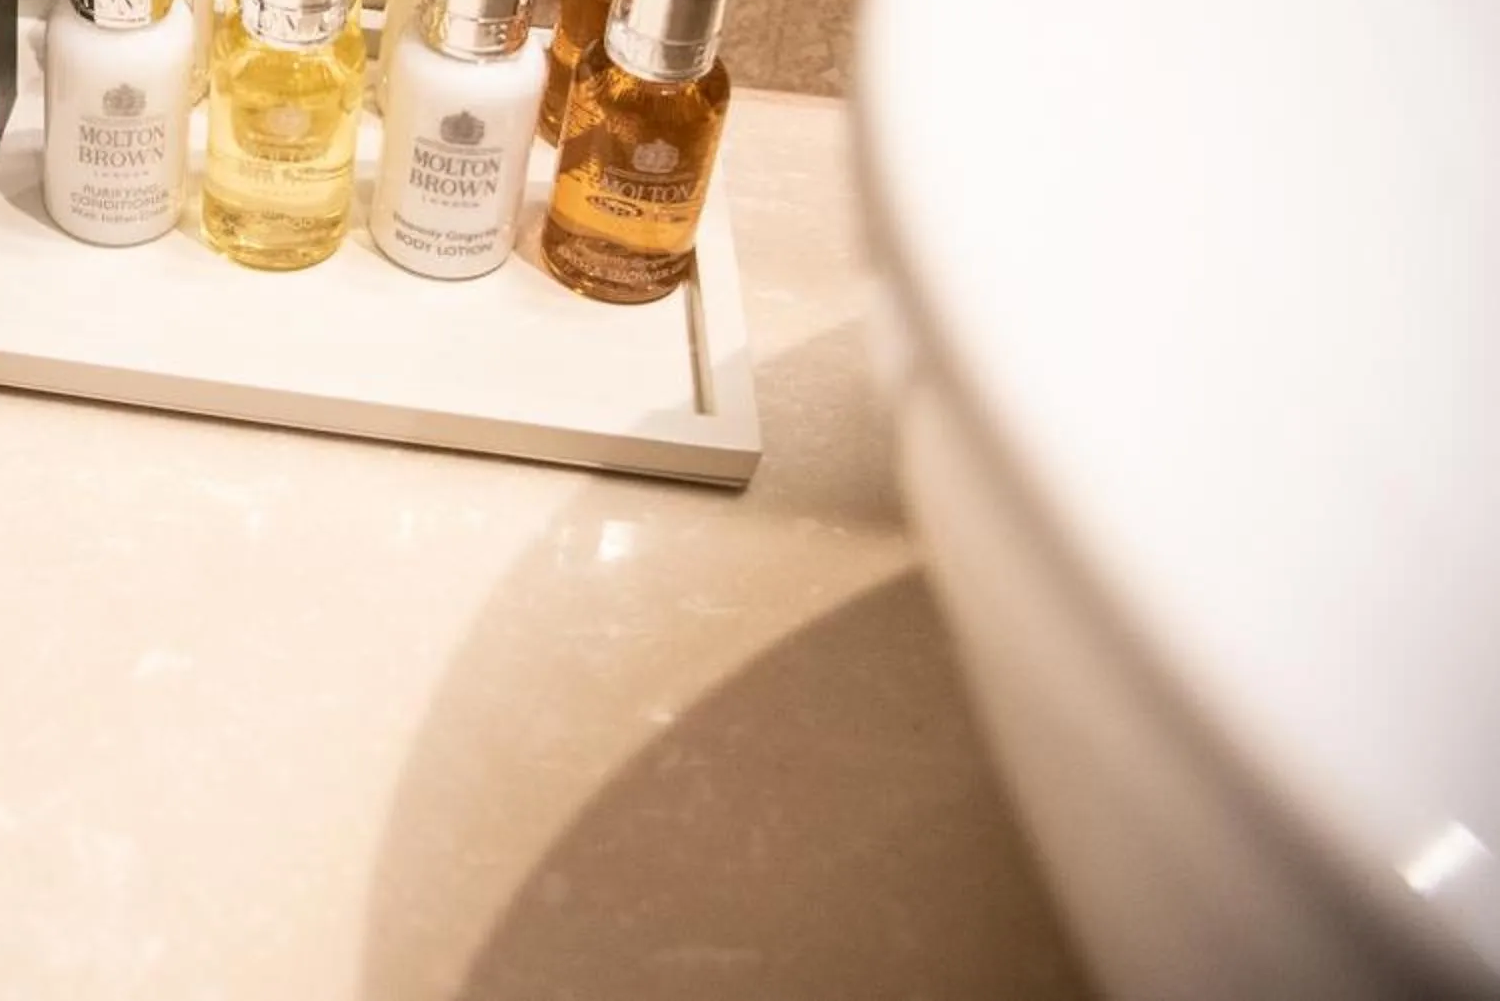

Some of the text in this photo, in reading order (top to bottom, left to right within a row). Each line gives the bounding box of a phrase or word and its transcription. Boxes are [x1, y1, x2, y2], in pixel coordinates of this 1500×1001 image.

[78, 122, 166, 148] MOLTON
[78, 144, 166, 168] BROWN
[412, 145, 501, 177] MOLTON
[409, 166, 498, 198] BROWN
[436, 240, 495, 257] LOTION
